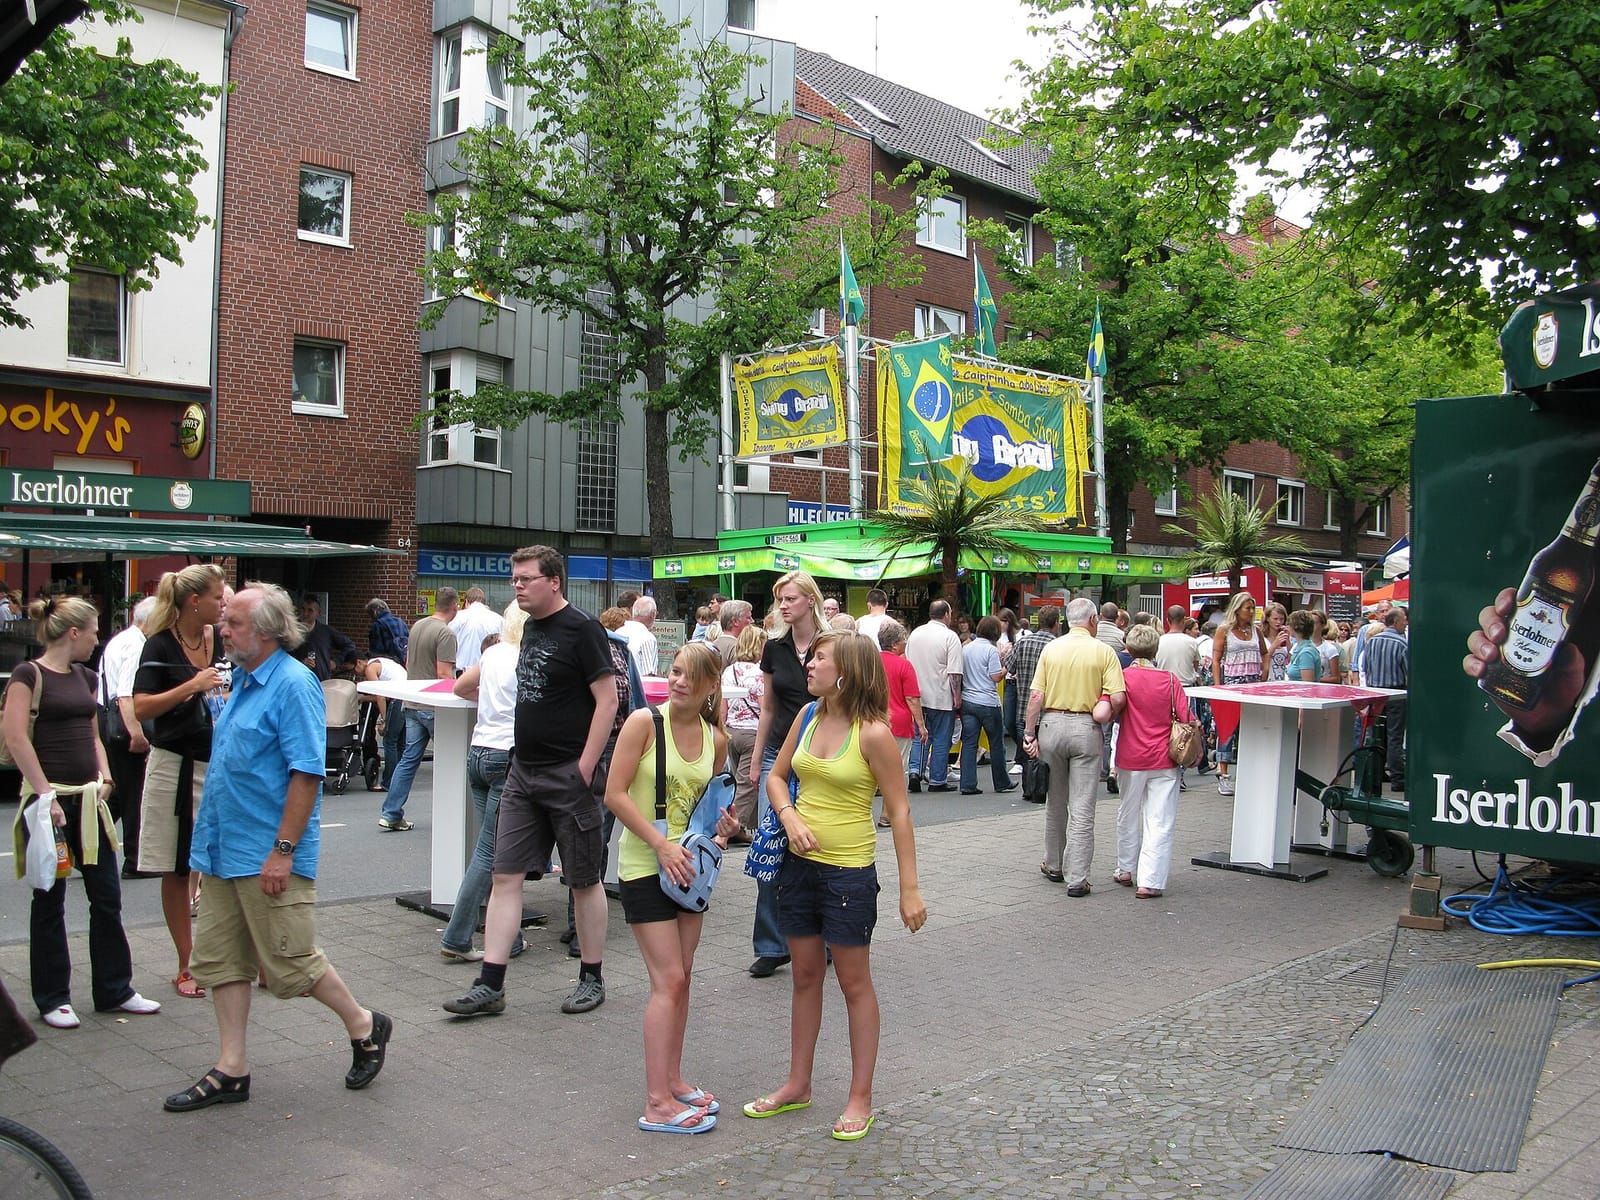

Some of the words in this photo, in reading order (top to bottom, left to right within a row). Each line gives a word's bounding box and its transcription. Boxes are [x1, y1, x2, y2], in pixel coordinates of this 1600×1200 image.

[963, 370, 1016, 389] Caipirinha
[760, 401, 789, 417] Swing
[794, 393, 829, 413] Brazil
[0, 388, 131, 455] oky's
[997, 393, 1031, 428] Samba
[1032, 416, 1061, 449] Show
[992, 435, 1054, 472] Brazil
[11, 472, 133, 508] Iserlohner
[397, 538, 412, 548] 64
[431, 555, 511, 573] SCHLEC
[1510, 619, 1557, 649] Iserlohner
